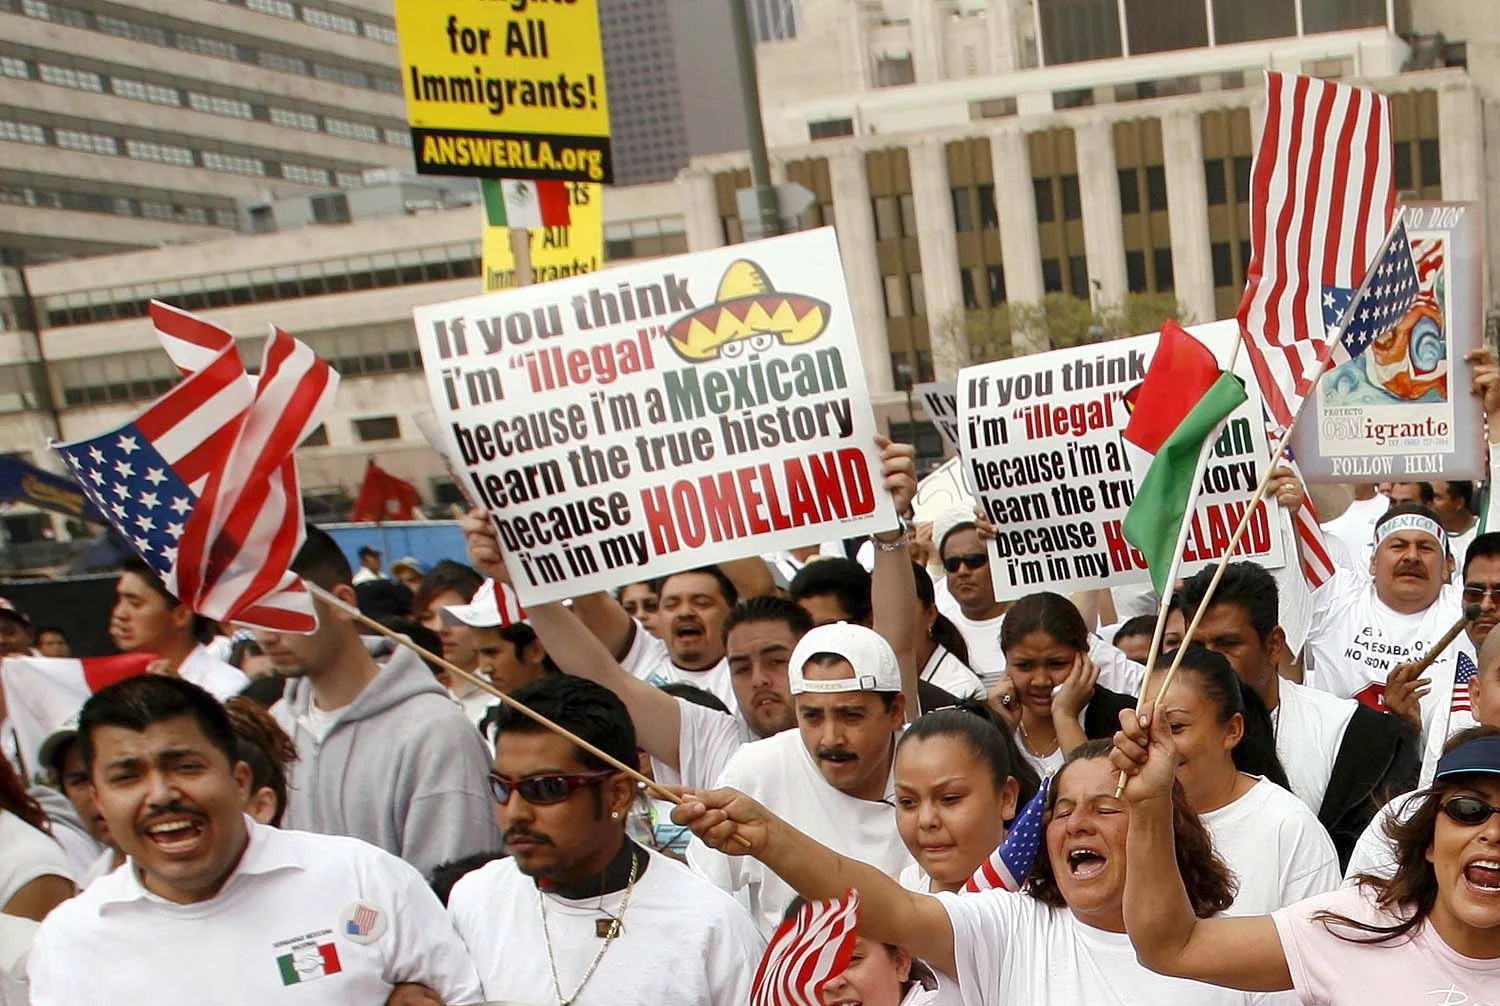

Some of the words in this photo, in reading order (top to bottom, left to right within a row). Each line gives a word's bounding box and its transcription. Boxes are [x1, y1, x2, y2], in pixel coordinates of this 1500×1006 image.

[447, 16, 490, 56] for
[505, 20, 548, 58] All
[410, 66, 598, 115] Immigrants!
[423, 136, 604, 180] ANSWERLA.org
[433, 315, 468, 360] If
[476, 303, 563, 355] you
[571, 273, 697, 331] think
[442, 366, 504, 410] i'm
[968, 376, 990, 409] If
[996, 369, 1053, 407] you
[1062, 349, 1146, 393] think
[453, 403, 587, 466] because
[590, 391, 642, 435] i'm
[644, 387, 666, 426] a
[663, 345, 848, 423] Mexican
[1324, 407, 1363, 417] PROYECTO
[968, 414, 1008, 449] i'm
[470, 458, 565, 511] learn
[568, 443, 631, 488] the
[634, 426, 714, 473] true
[718, 397, 854, 456] history
[971, 449, 1065, 492] because
[1067, 442, 1103, 477] i'm
[1105, 441, 1122, 472] a
[1331, 456, 1394, 476] FOLLOW
[1404, 454, 1443, 474] HIM!
[492, 491, 631, 552] because
[518, 551, 562, 587] i'm
[564, 543, 597, 578] in
[597, 530, 650, 567] my
[640, 447, 877, 555] HOMELAND
[981, 493, 1049, 525] learn
[1052, 484, 1096, 517] the
[1381, 515, 1434, 536] MEXICO
[995, 521, 1097, 558] because
[1007, 556, 1044, 587] i'm
[1047, 554, 1071, 582] in
[1073, 551, 1109, 578] my
